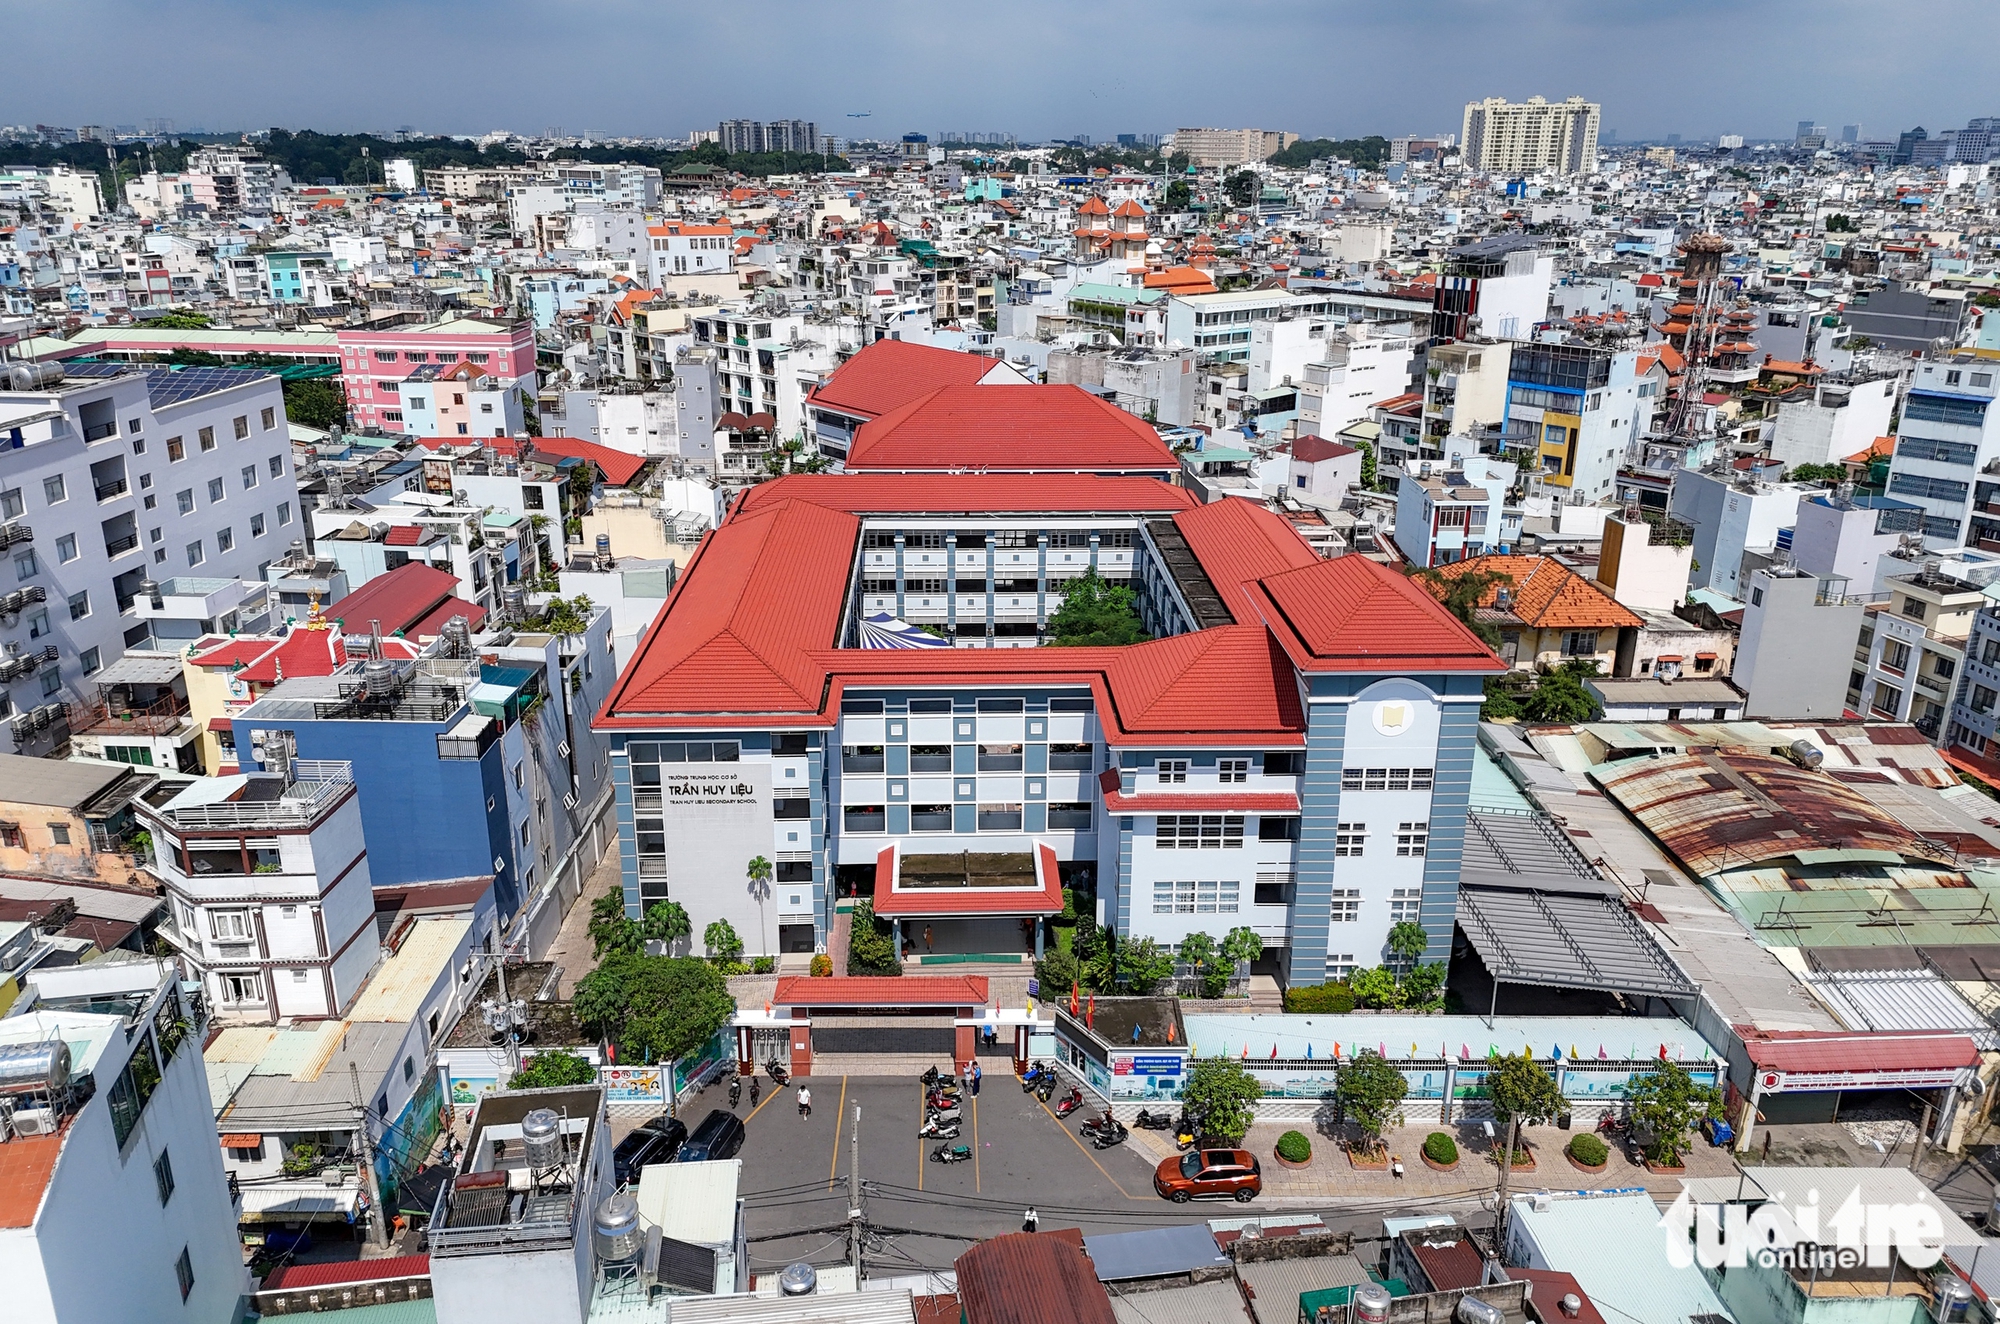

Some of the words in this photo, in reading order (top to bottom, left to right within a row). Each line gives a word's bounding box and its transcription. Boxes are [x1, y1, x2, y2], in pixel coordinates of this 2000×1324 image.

[669, 782, 699, 796] TRẦN
[703, 785, 726, 795] HUY
[730, 783, 753, 797] LIỆU
